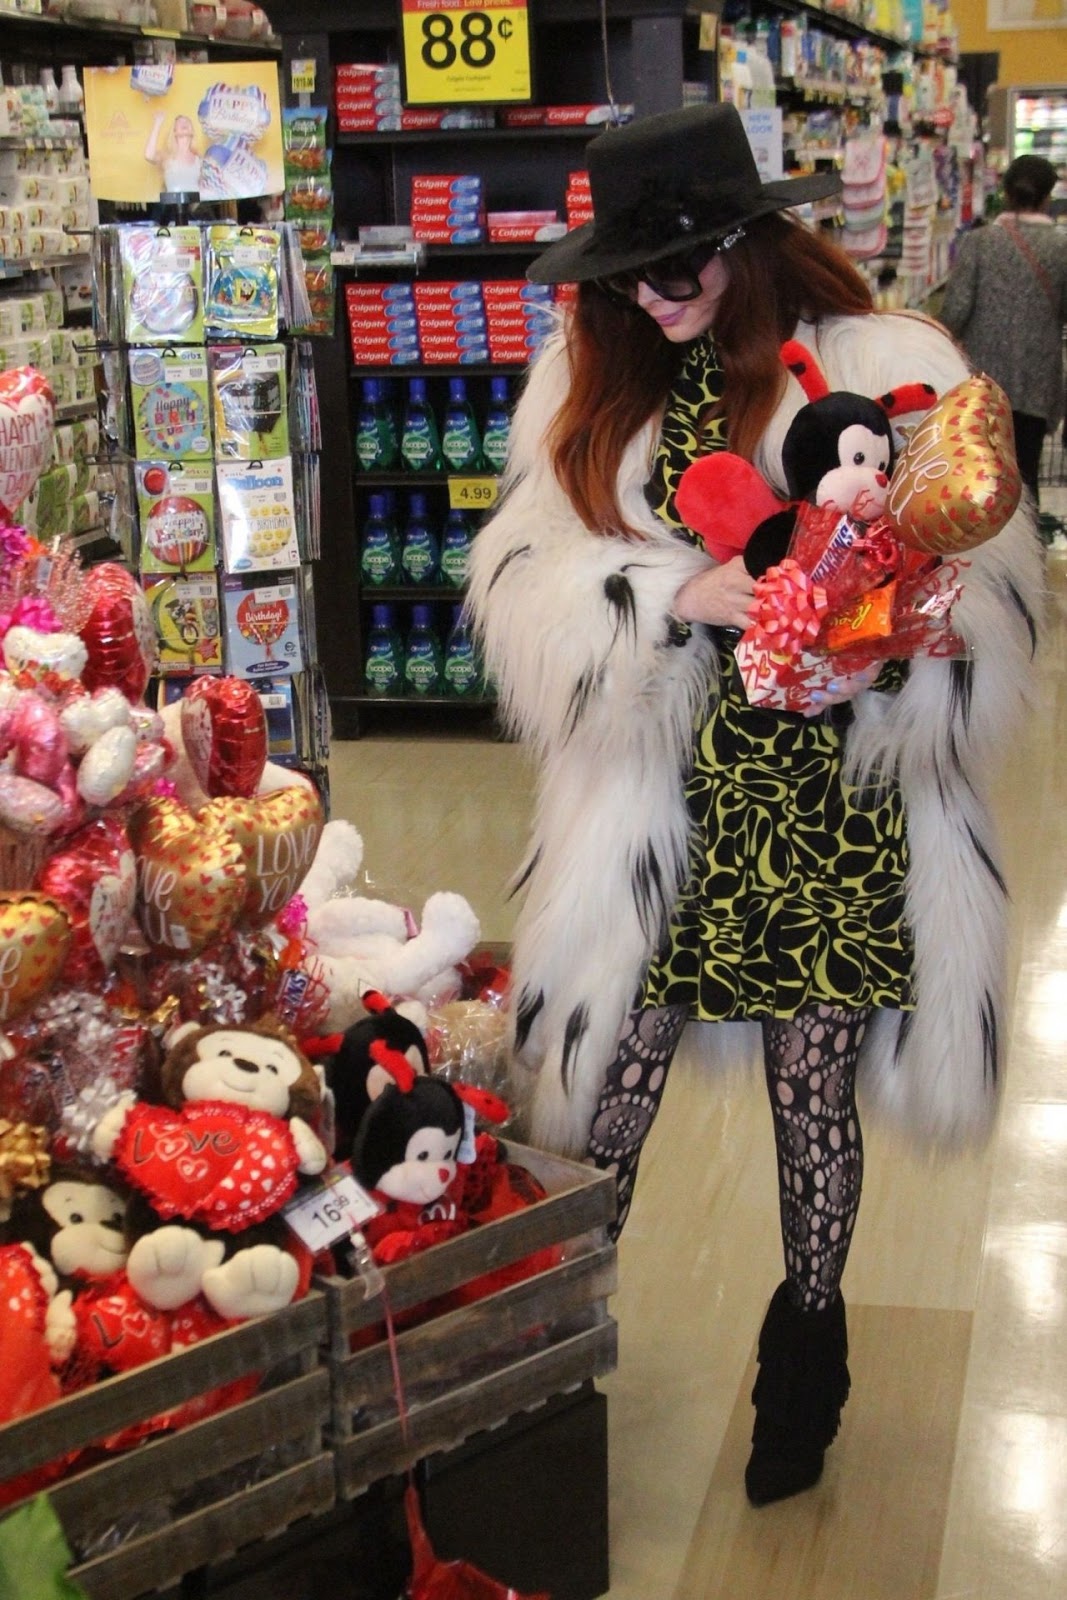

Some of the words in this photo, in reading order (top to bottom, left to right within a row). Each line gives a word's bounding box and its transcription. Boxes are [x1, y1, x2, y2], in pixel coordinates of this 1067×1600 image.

[337, 85, 372, 95] Colgate
[338, 100, 373, 111] Colgate
[548, 111, 585, 120] Colgate
[340, 118, 375, 129] Colgate
[402, 116, 438, 125] Colgate
[414, 180, 450, 190] Colgate
[414, 197, 448, 206] Colgate
[412, 214, 446, 223] Colgate
[415, 230, 450, 240] Colgate
[498, 229, 534, 238] Colgate
[347, 288, 380, 297] Colgate
[415, 286, 450, 295] Colgate
[484, 286, 519, 295] Colgate
[349, 304, 383, 313] Colgate
[418, 303, 452, 312] Colgate
[487, 303, 521, 312] Colgate
[352, 320, 386, 329] Colgate
[420, 319, 455, 328] Colgate
[489, 318, 524, 327] Colgate
[353, 336, 387, 345] Colgate
[422, 335, 456, 344] Colgate
[489, 334, 524, 344] Colgate
[356, 352, 390, 361] Colgate
[424, 351, 458, 360] Colgate
[492, 350, 528, 359] Colgate
[460, 487, 491, 501] 4.99
